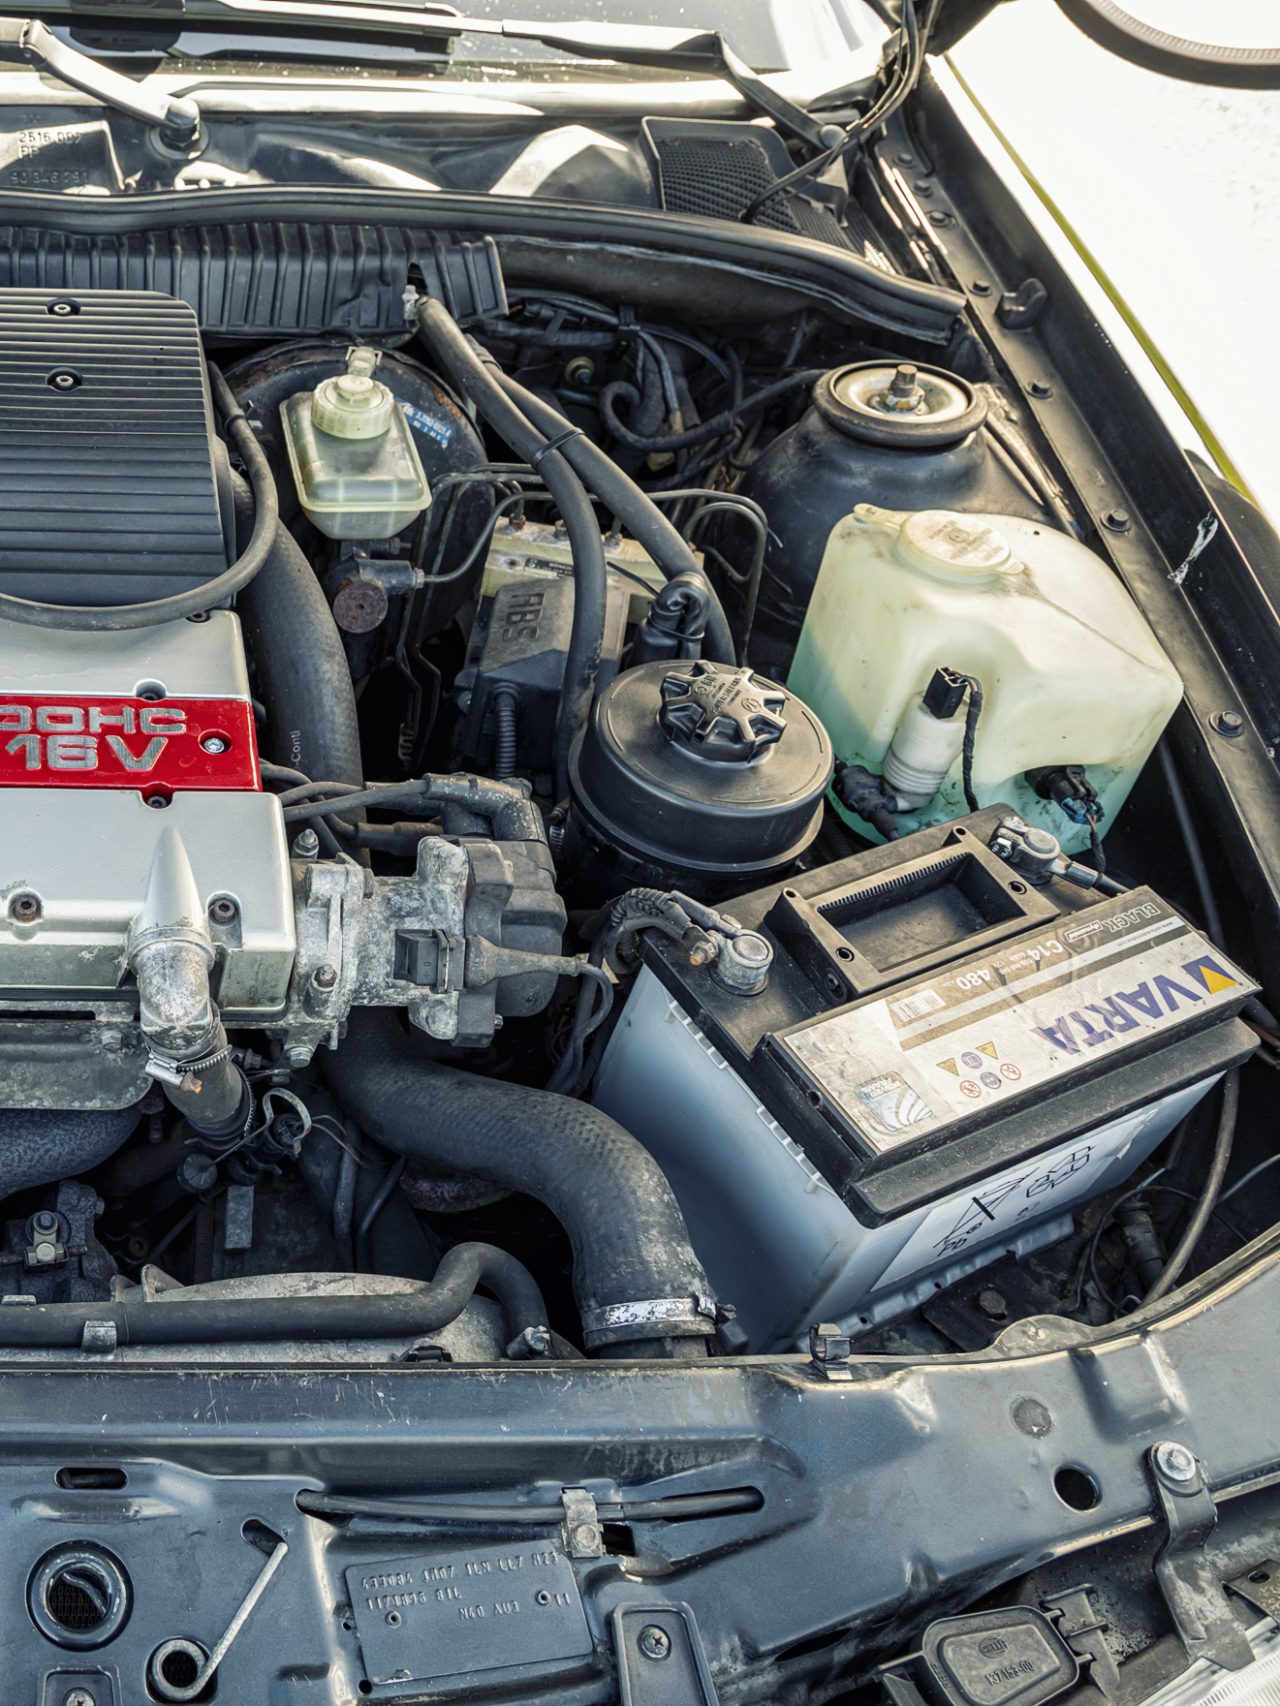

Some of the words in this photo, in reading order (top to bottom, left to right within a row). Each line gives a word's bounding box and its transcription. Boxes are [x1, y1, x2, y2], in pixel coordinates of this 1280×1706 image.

[502, 592, 546, 642] ABS
[6, 734, 168, 772] 16V
[1104, 902, 1161, 932] BLACK
[1027, 938, 1064, 962] C14
[956, 968, 992, 990] 480
[1031, 974, 1203, 1056] VARTA
